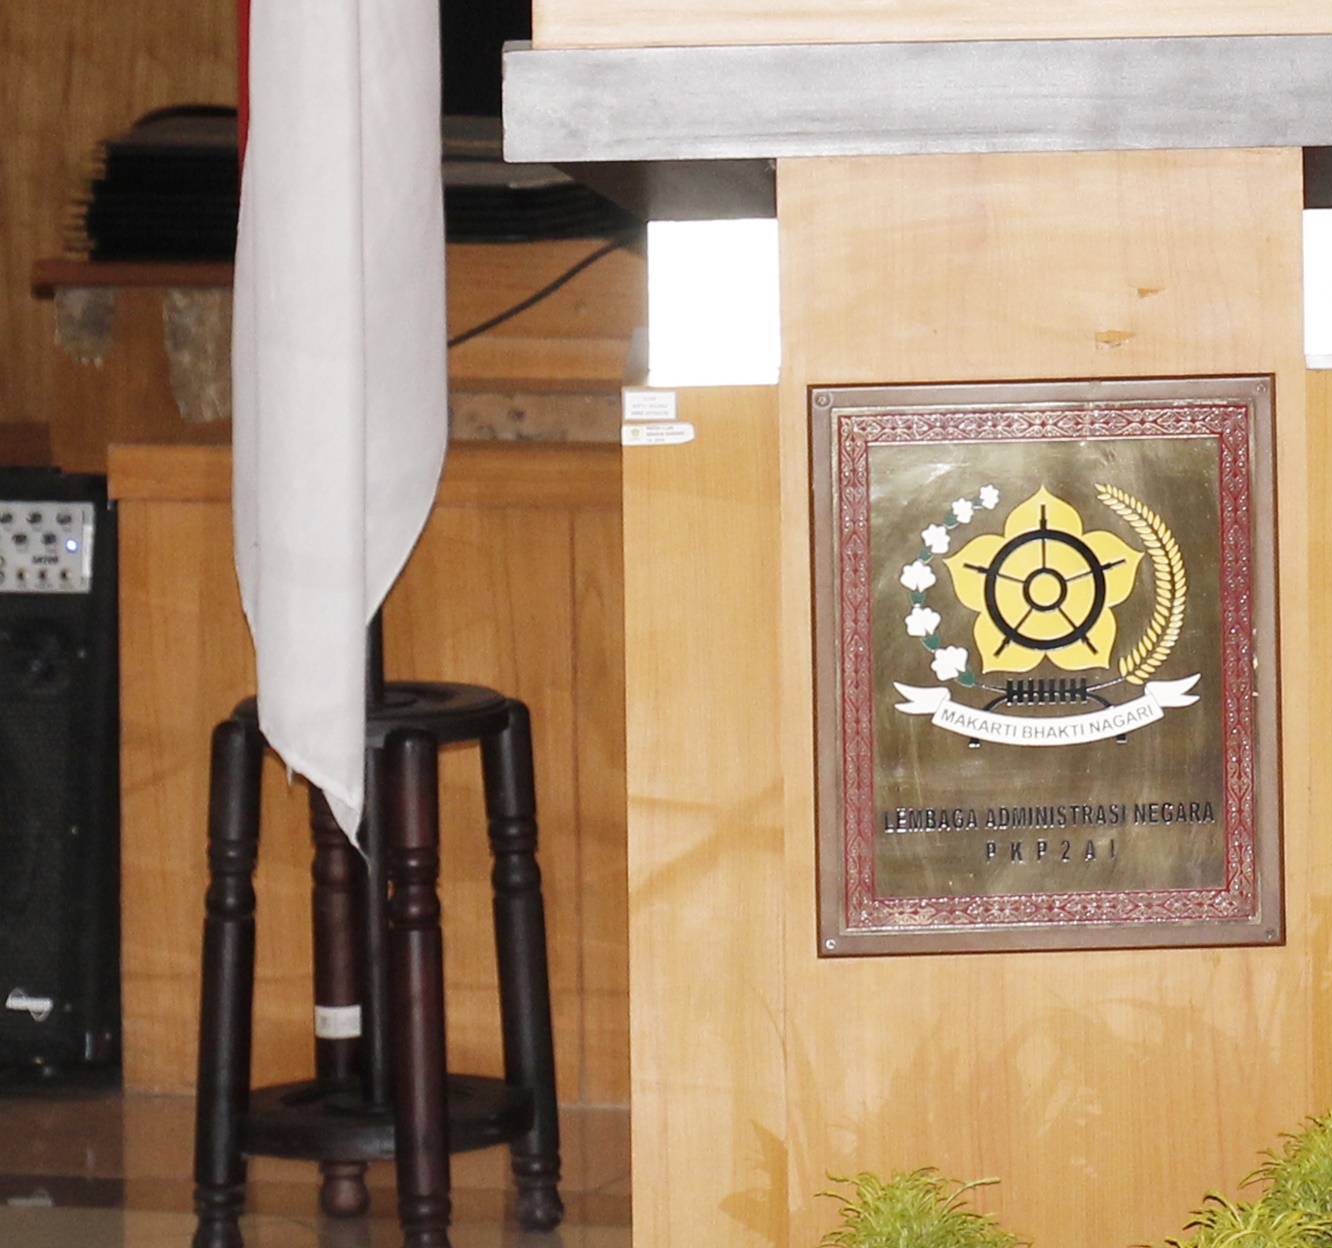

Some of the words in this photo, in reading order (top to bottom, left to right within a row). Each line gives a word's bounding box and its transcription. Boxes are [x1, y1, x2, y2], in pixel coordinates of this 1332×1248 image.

[940, 708, 1017, 738] MAKARTI
[1021, 724, 1085, 739] BHAKTI
[1089, 704, 1154, 733] NAGARI
[884, 807, 978, 832] LEMBAGA
[985, 804, 1126, 829] ADMINISTRASI
[1133, 801, 1215, 826] NEGARA
